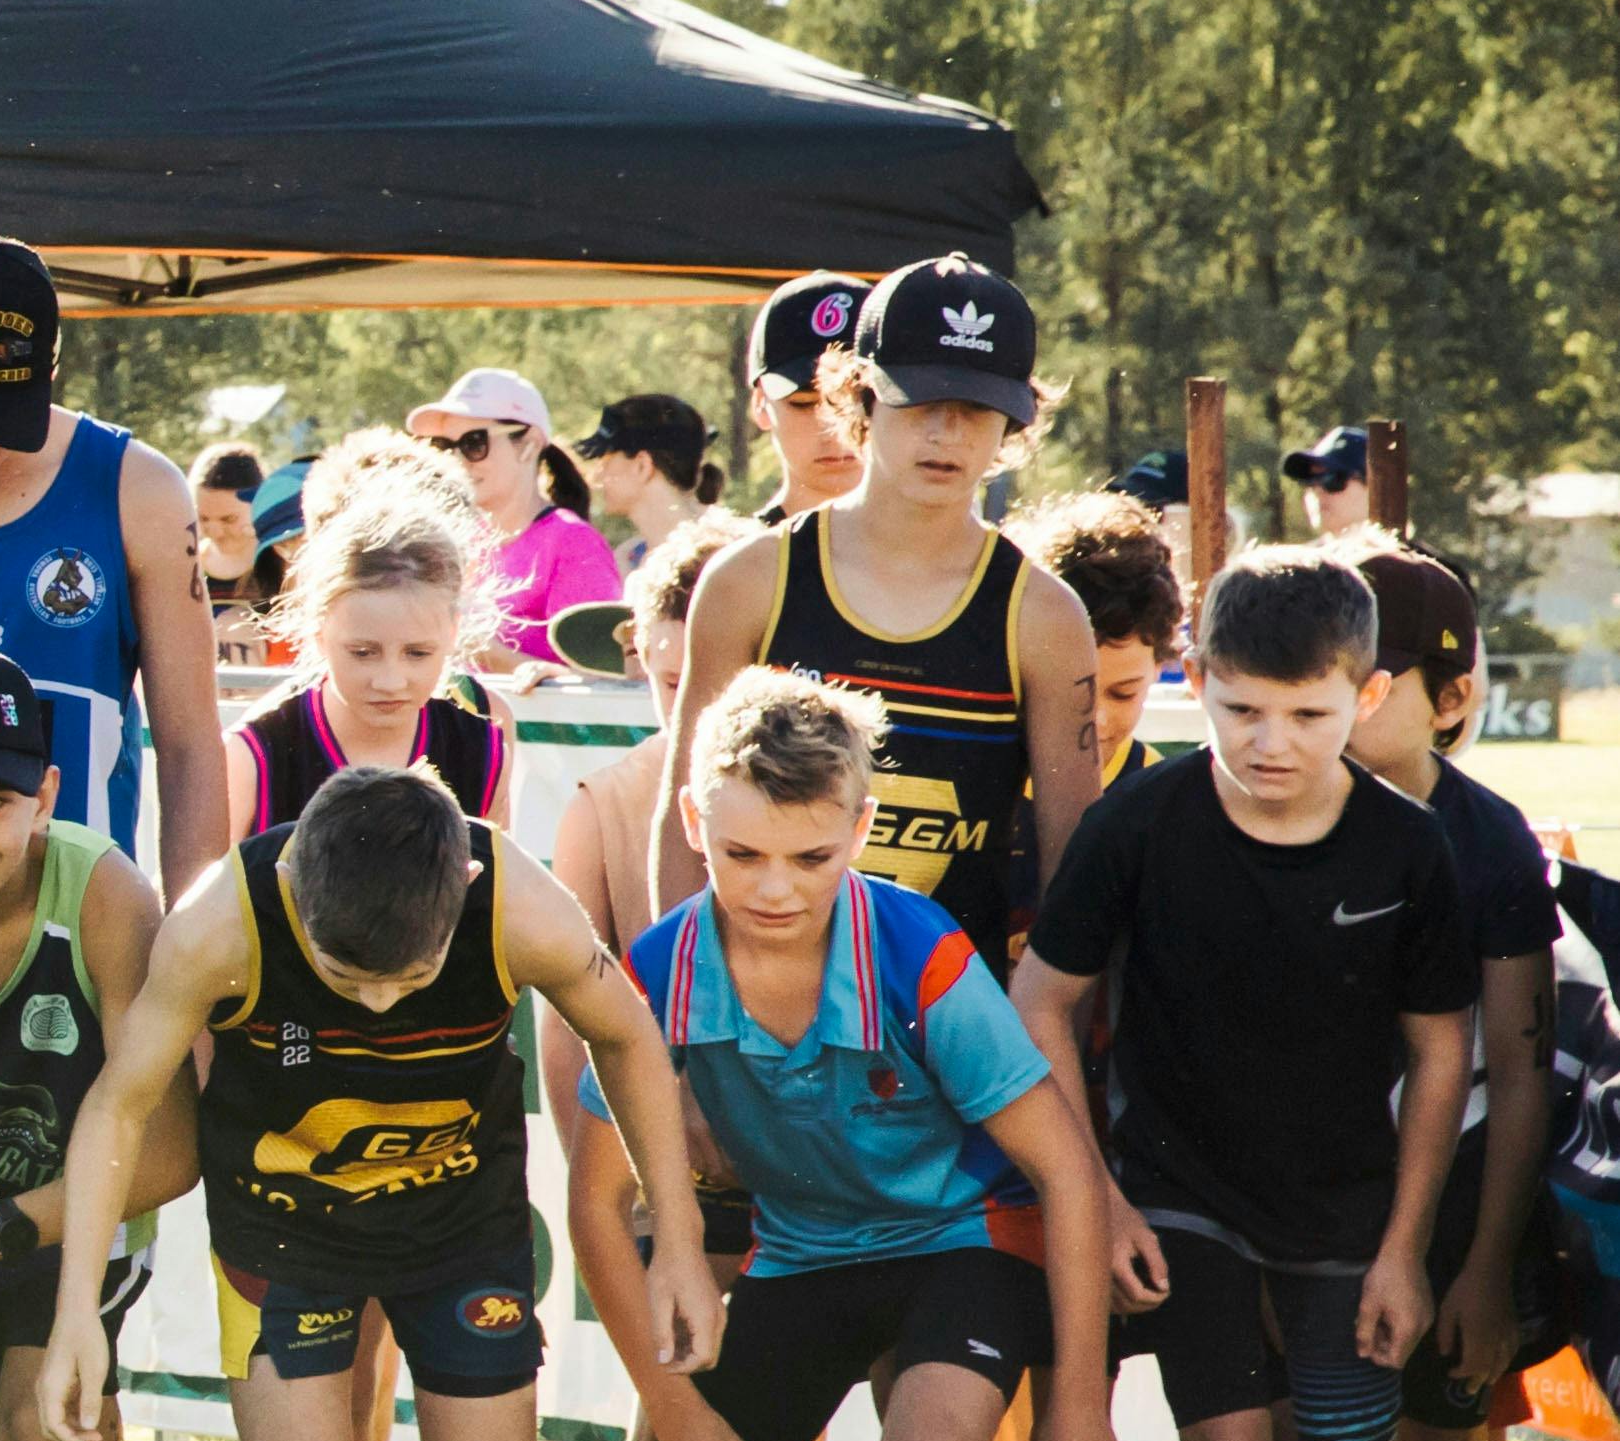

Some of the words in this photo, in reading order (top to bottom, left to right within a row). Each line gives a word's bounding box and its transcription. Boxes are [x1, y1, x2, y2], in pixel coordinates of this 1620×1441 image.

[939, 334, 994, 353] adidas
[282, 1021, 310, 1042] 20
[282, 1044, 311, 1067] 22
